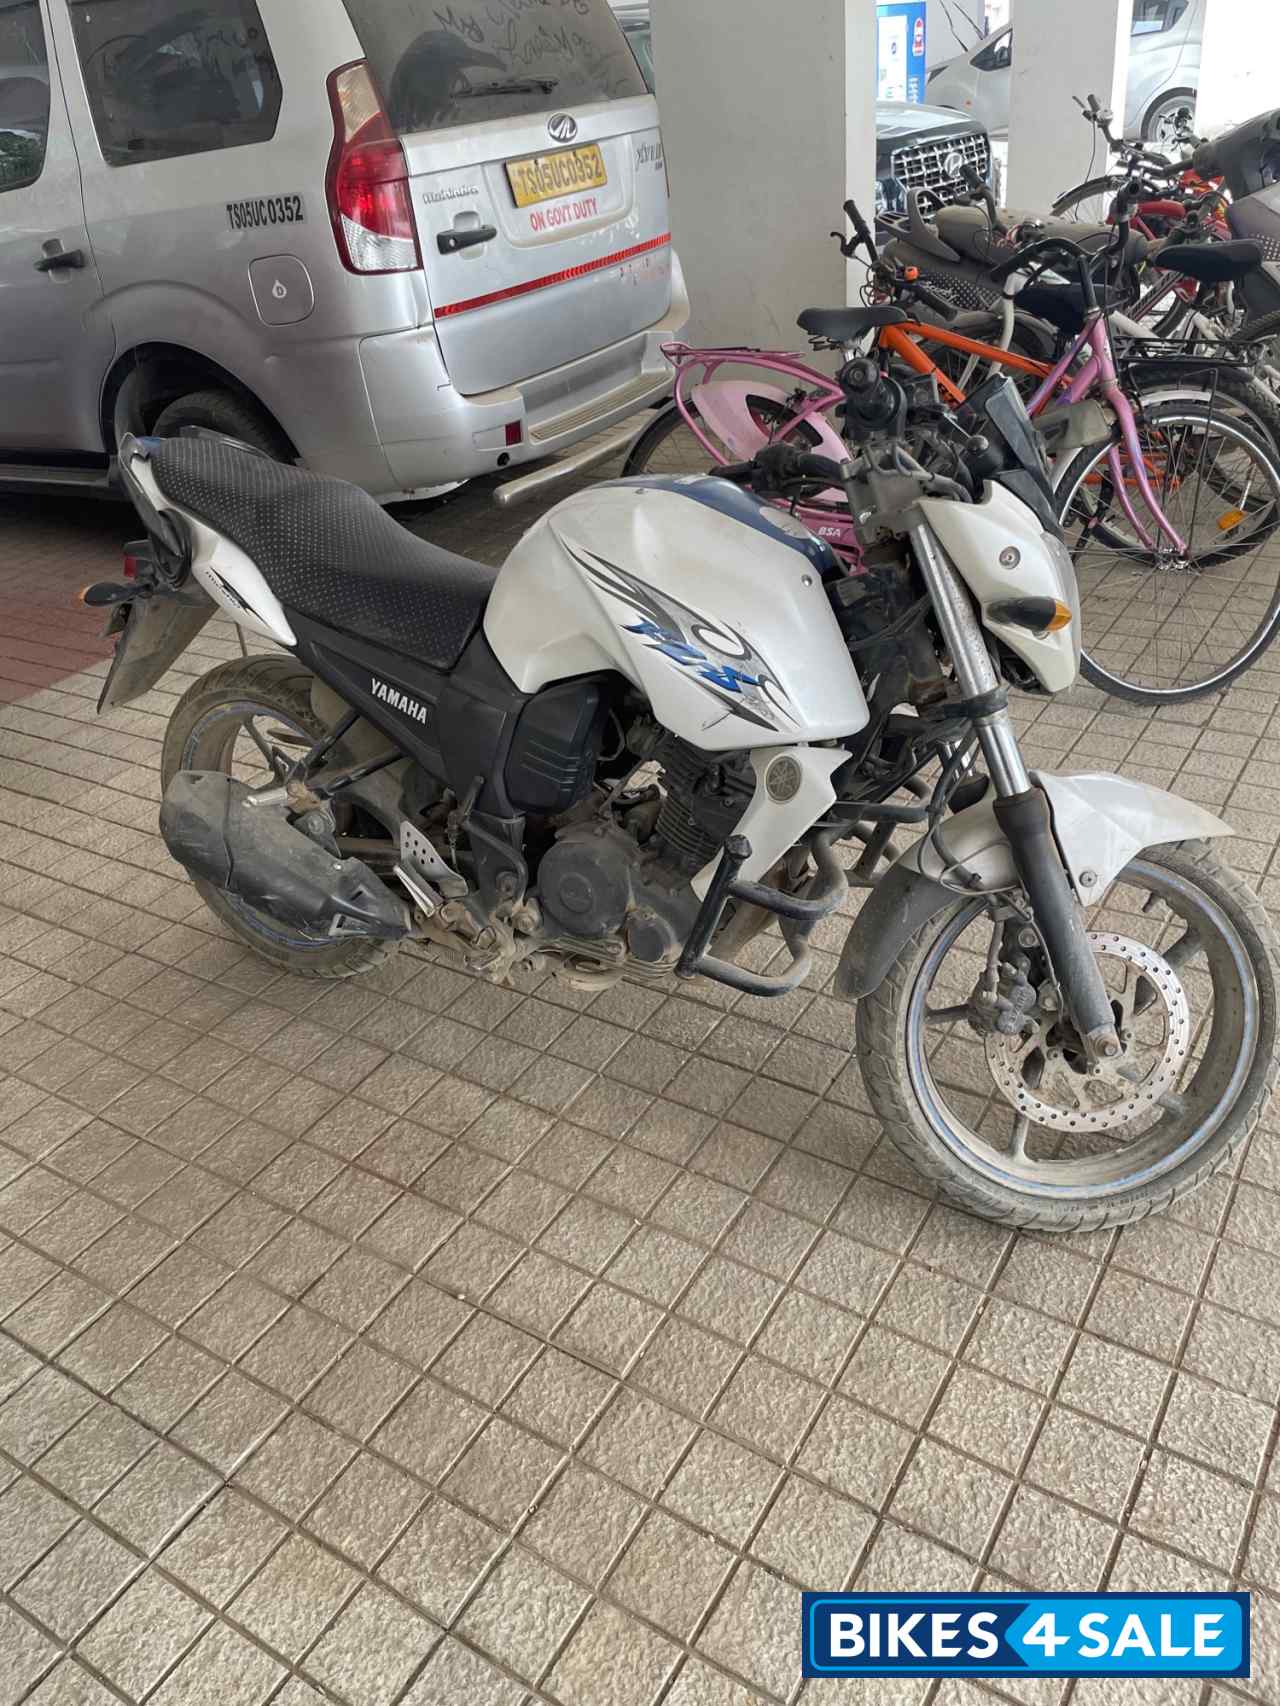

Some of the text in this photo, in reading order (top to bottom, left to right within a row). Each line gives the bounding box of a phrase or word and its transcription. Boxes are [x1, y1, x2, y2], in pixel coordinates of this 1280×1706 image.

[517, 154, 603, 196] TS05UC0352
[530, 197, 598, 231] ON GOVT DUTY
[818, 526, 841, 537] BSA
[371, 677, 428, 725] YAMAHA
